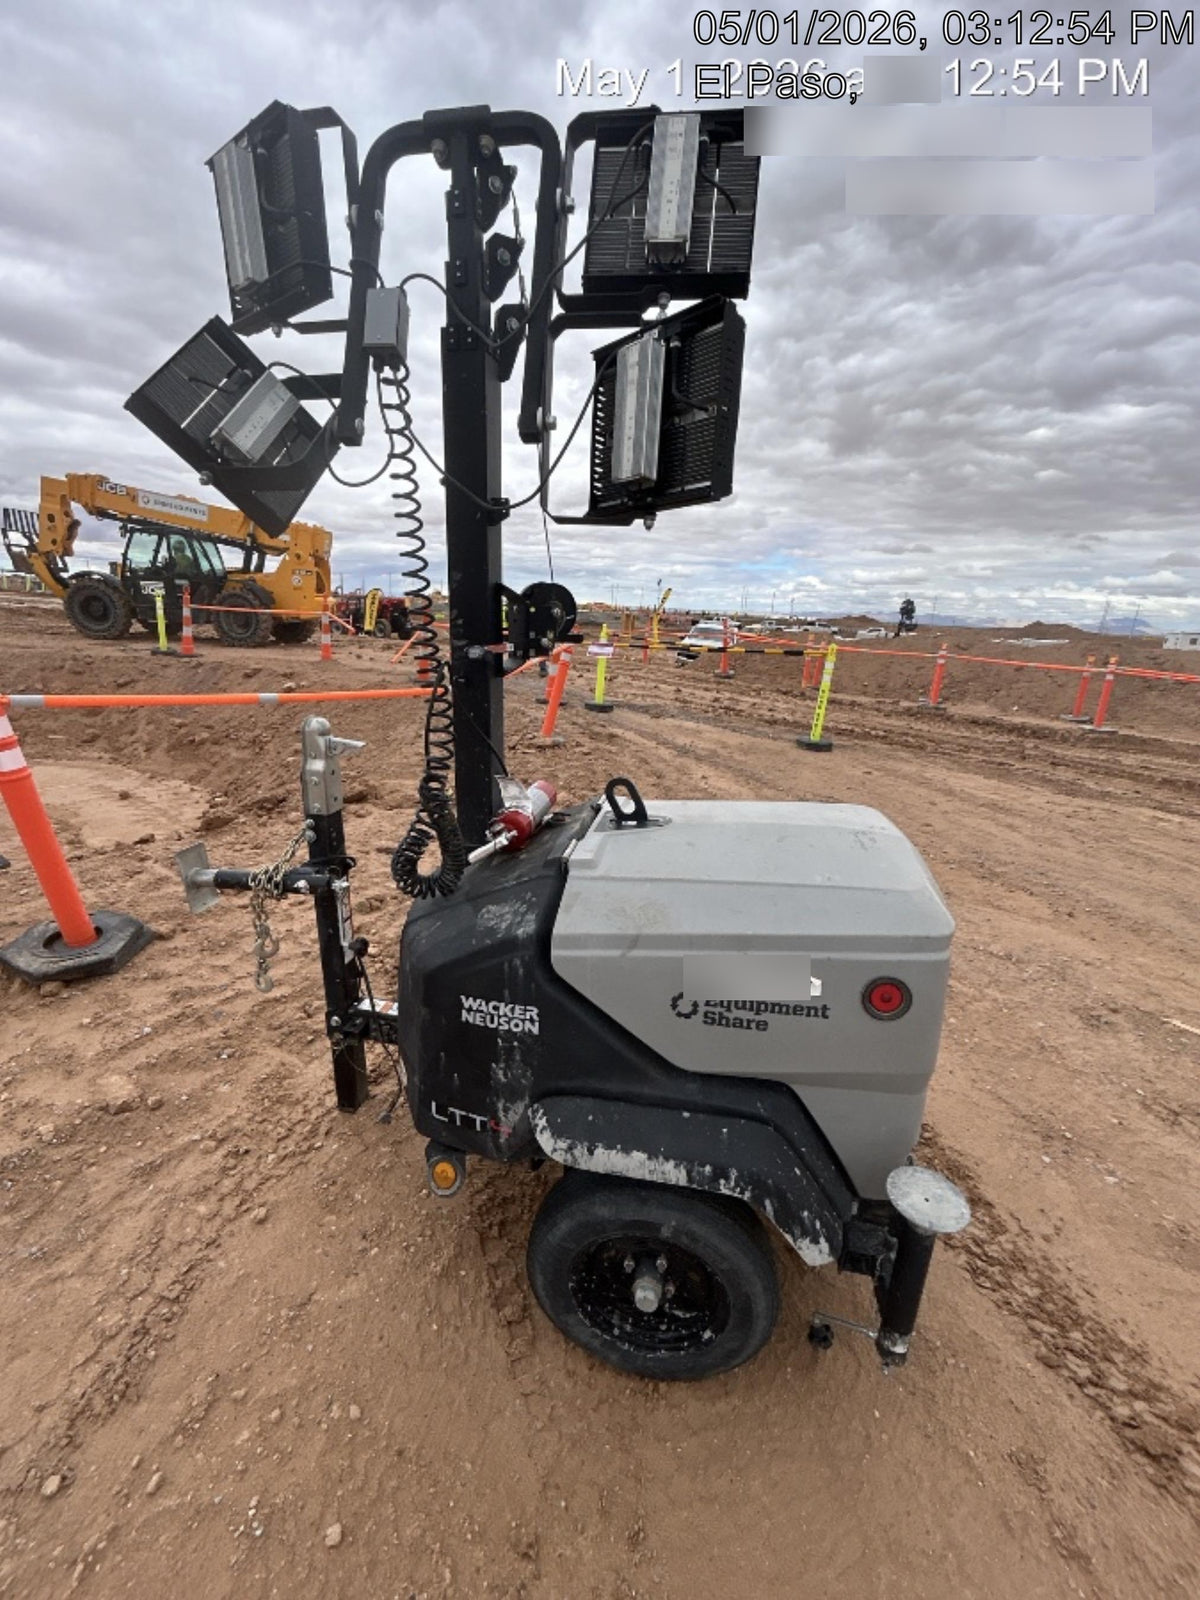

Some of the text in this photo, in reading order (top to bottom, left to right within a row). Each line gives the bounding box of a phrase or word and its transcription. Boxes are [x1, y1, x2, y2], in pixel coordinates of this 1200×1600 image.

[96, 480, 127, 495] JCB
[141, 585, 166, 595] JC
[460, 994, 540, 1021] WACKER
[461, 1009, 540, 1035] NEUSON
[702, 1010, 769, 1032] Share
